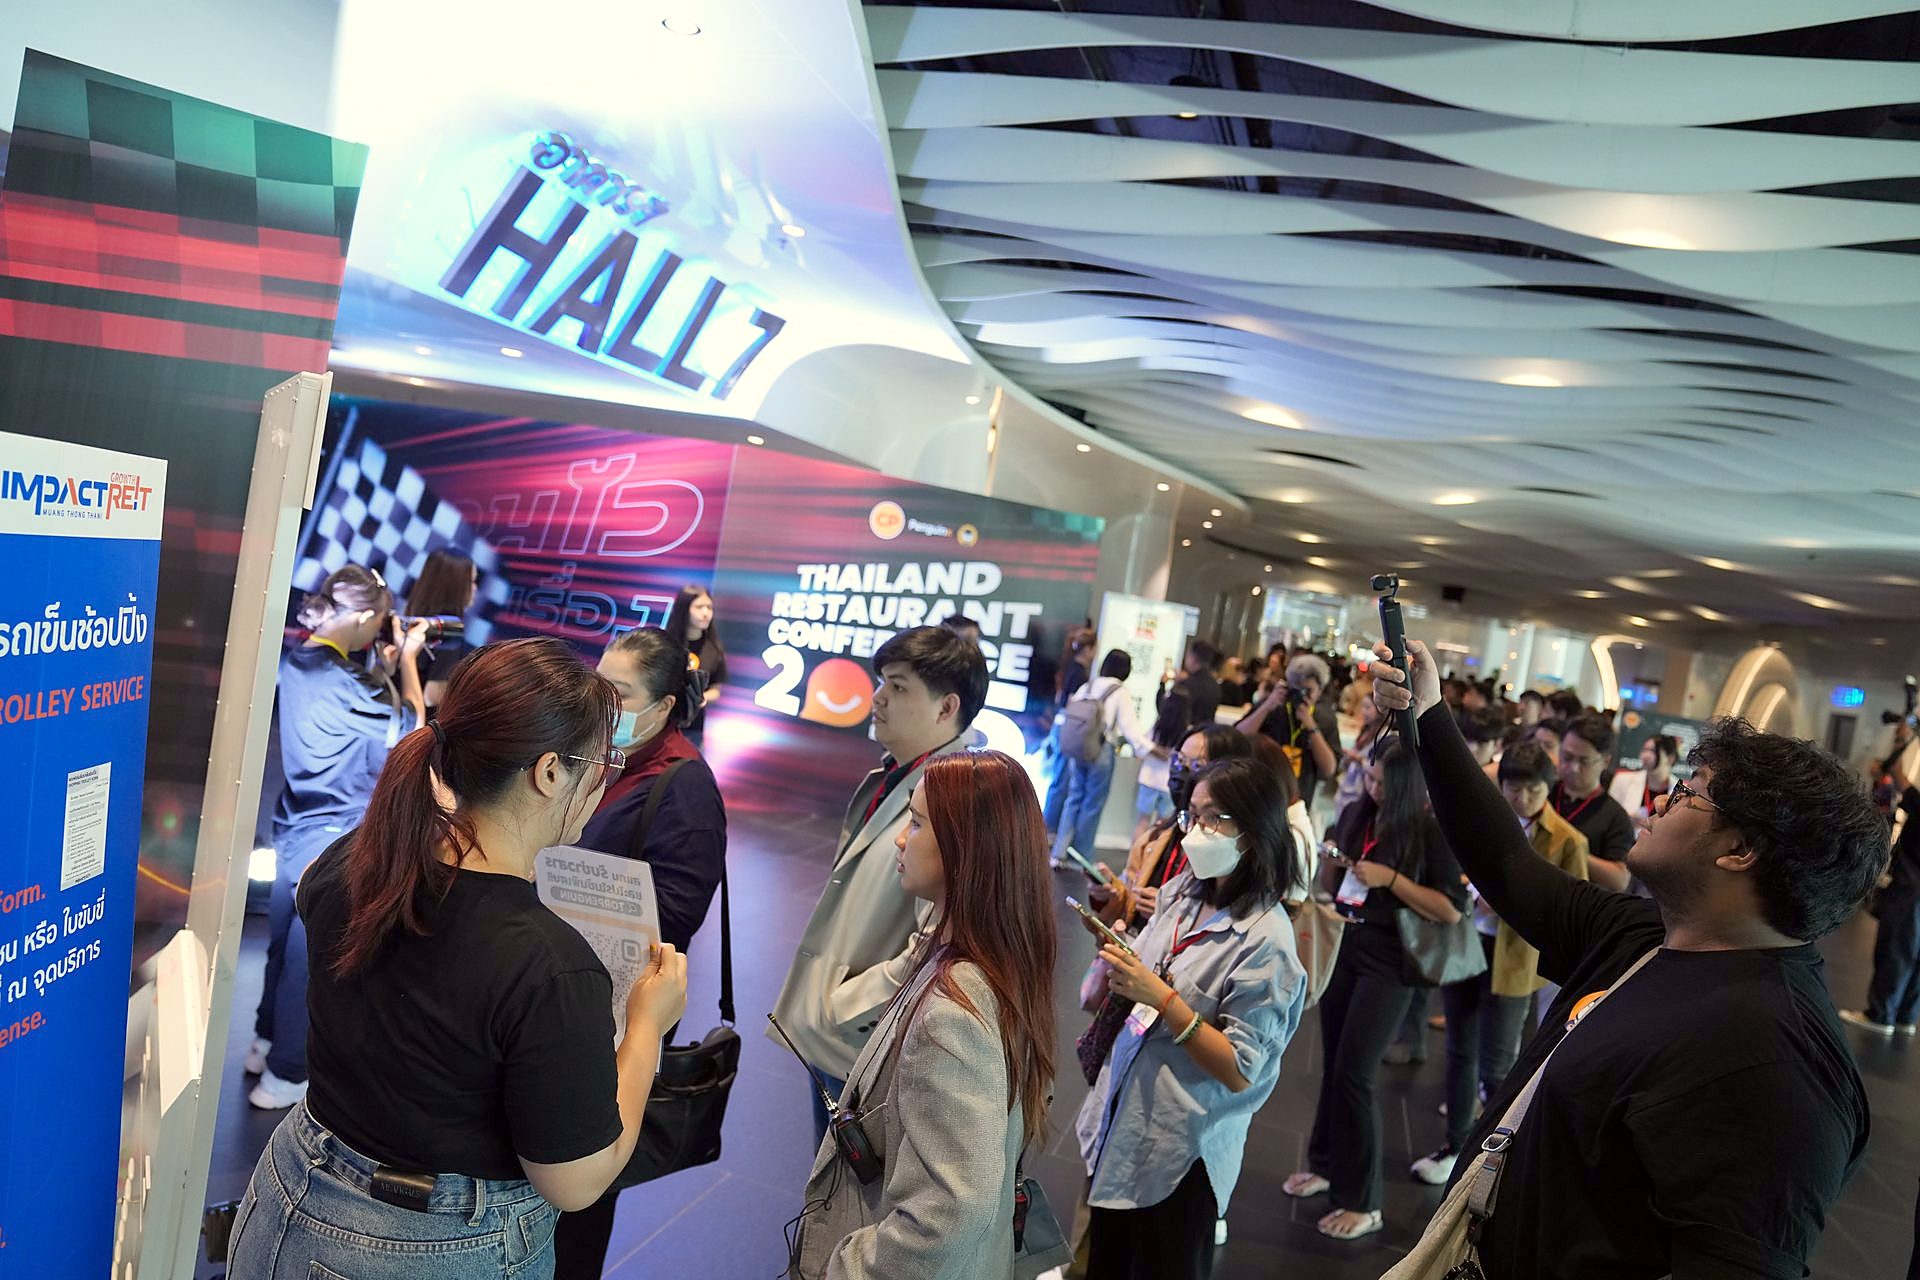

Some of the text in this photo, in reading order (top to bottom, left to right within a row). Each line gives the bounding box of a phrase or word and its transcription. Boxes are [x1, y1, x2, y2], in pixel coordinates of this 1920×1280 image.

[438, 164, 787, 401] HALL 7
[1, 470, 109, 516] IMPACT
[110, 472, 136, 485] GROWTH
[42, 509, 103, 520] MUANG THONG THANI
[797, 562, 1003, 596] THAILAND
[771, 592, 1044, 639] RESTAURANT
[0, 675, 145, 725] OLLEY SERVICE
[23, 919, 58, 955] หรือ
[62, 887, 106, 937] ใบขับขี่
[7, 976, 27, 1004] ณ
[33, 939, 101, 997] จุดบริการ
